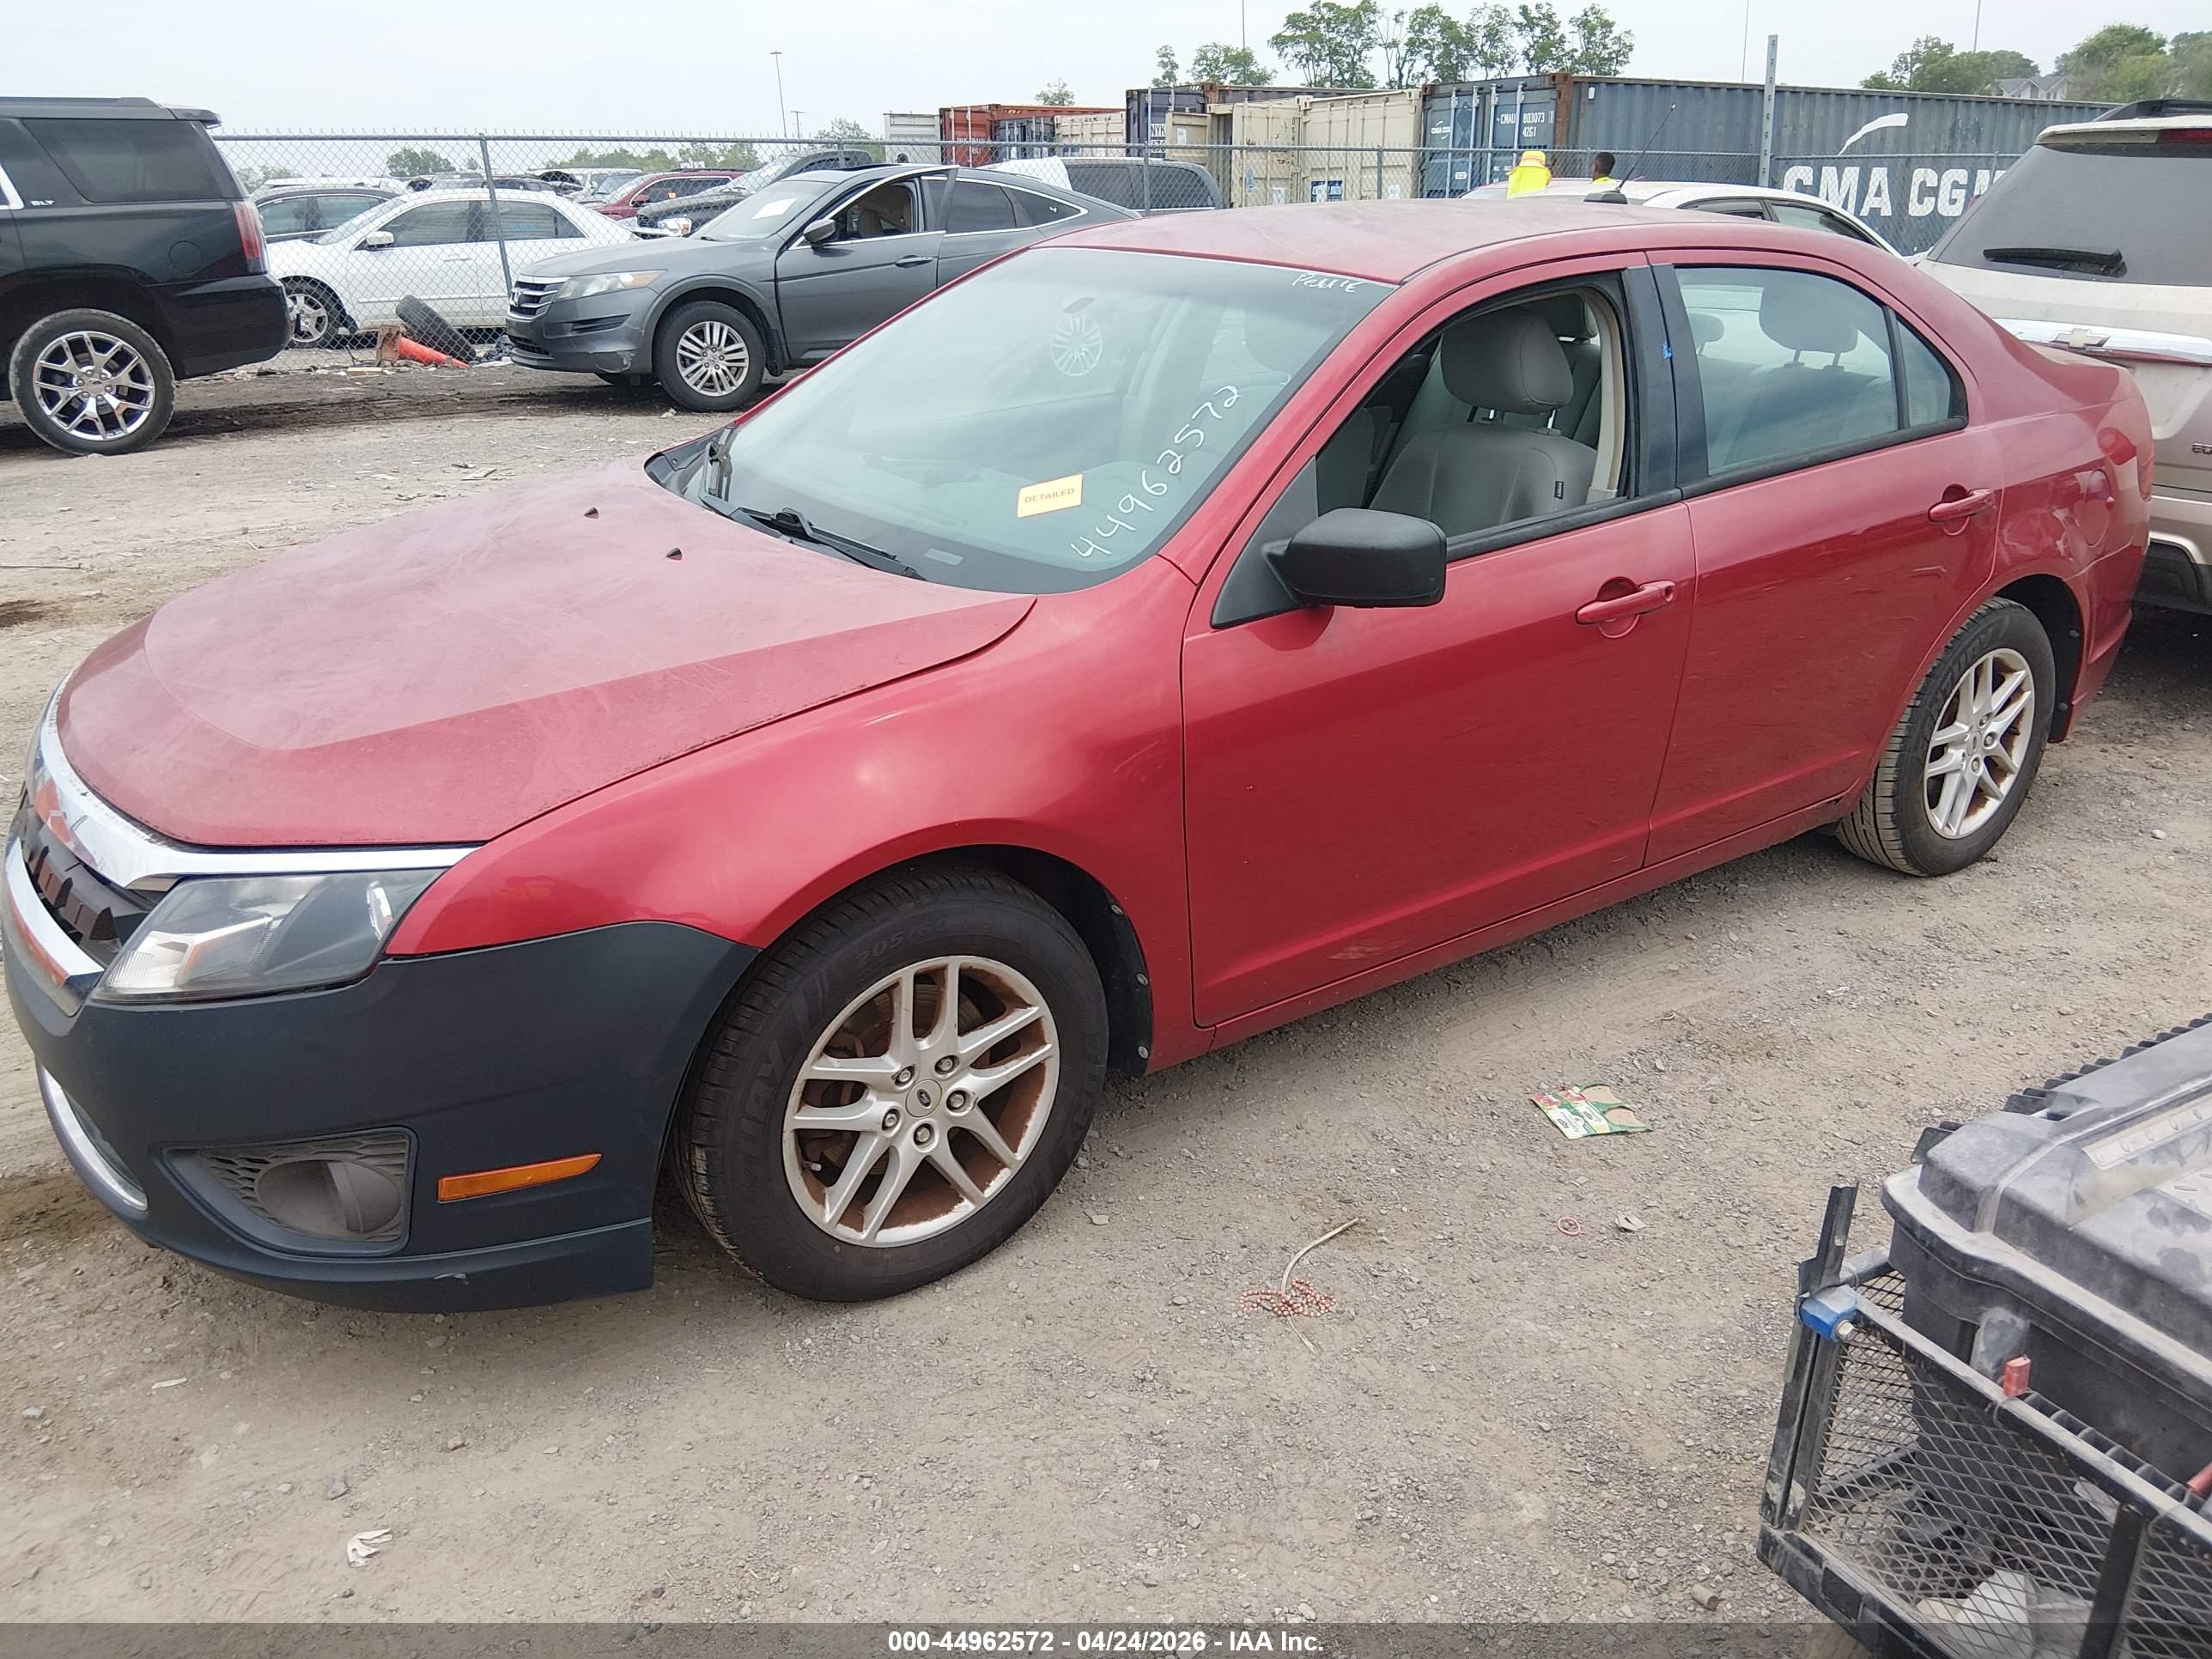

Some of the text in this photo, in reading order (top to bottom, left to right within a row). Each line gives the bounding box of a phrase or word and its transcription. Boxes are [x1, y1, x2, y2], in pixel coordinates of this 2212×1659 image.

[1150, 124, 1166, 137] NYK
[1070, 385, 1242, 557] 44962572
[1024, 488, 1075, 503] DETAILED
